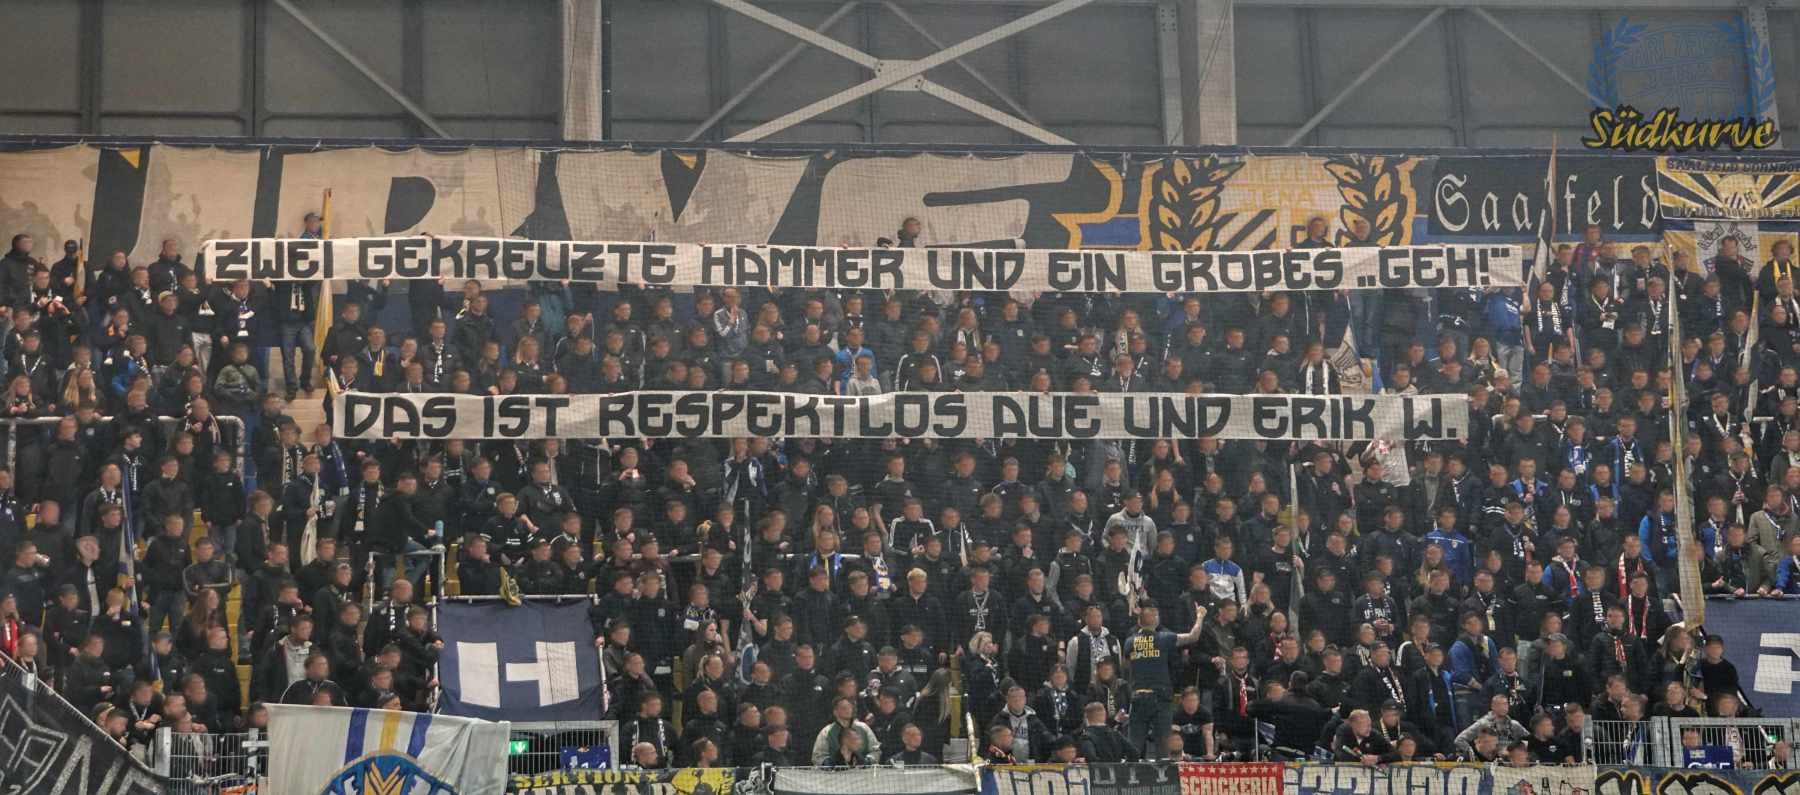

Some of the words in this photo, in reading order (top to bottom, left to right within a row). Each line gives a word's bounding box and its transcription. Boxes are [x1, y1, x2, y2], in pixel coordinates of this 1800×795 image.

[1435, 173, 1658, 235] Saafeld
[215, 241, 333, 280] ZWEI
[359, 239, 676, 284] GEKREUZTE
[927, 250, 1025, 290] UND
[1048, 252, 1127, 291] EIN
[344, 396, 457, 437] DAS
[484, 397, 570, 437] IST
[599, 394, 967, 437] RESPEKTLOS
[993, 396, 1101, 438] AUE
[1124, 397, 1230, 439] UND
[1253, 397, 1375, 439] ERIK
[1403, 398, 1457, 439] W.
[1134, 642, 1154, 650] YOUR
[1180, 776, 1278, 795] SCHICKERIA
